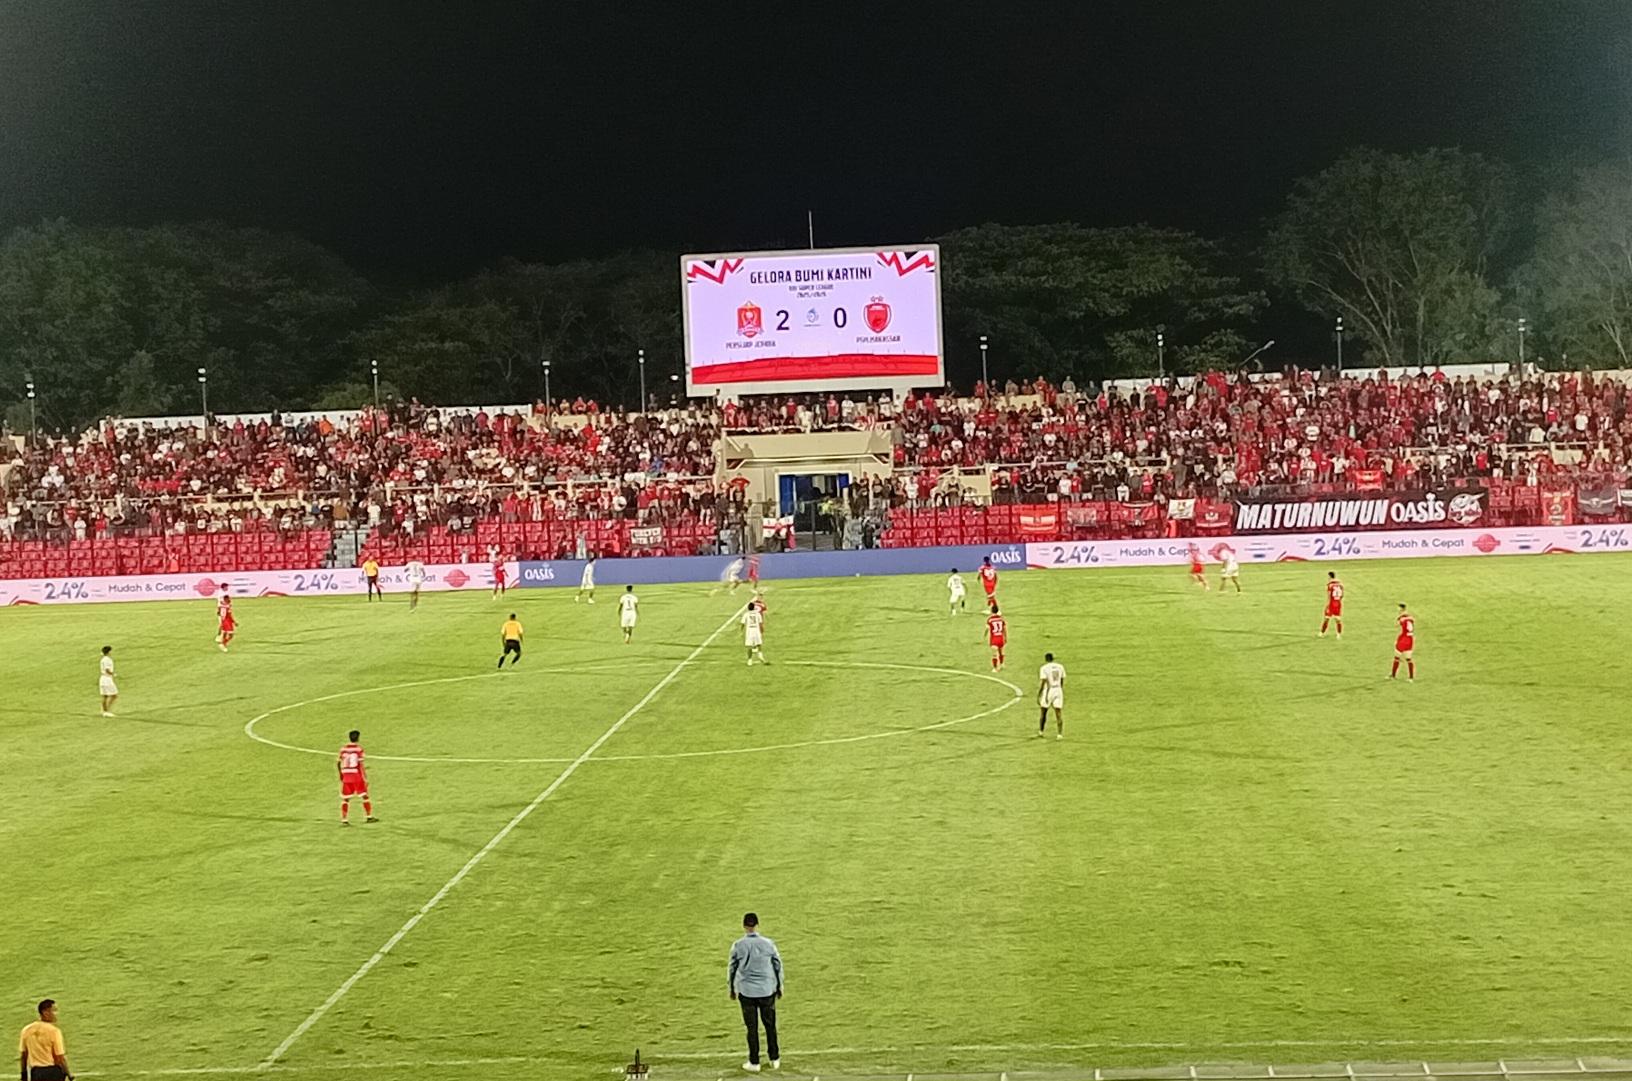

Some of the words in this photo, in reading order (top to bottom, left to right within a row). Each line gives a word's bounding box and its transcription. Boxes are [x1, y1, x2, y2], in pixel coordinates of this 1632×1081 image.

[750, 270, 792, 284] GELORA
[794, 268, 824, 282] BUMI
[827, 266, 872, 281] KARTINI
[776, 310, 790, 330] 2
[833, 307, 847, 328] 0
[1236, 499, 1389, 530] MATURNUWUN
[1390, 494, 1446, 523] OASIS
[1382, 539, 1418, 549] Mudah
[1421, 538, 1429, 547] &
[1432, 538, 1465, 549] Cepat
[991, 549, 1021, 564] OASIS
[1120, 548, 1155, 557] Mudah
[1158, 547, 1166, 556] &
[395, 574, 402, 583] &
[524, 565, 554, 580] OASIS
[108, 583, 142, 593] Mudah
[145, 583, 153, 592] &
[156, 582, 186, 594] Cepat
